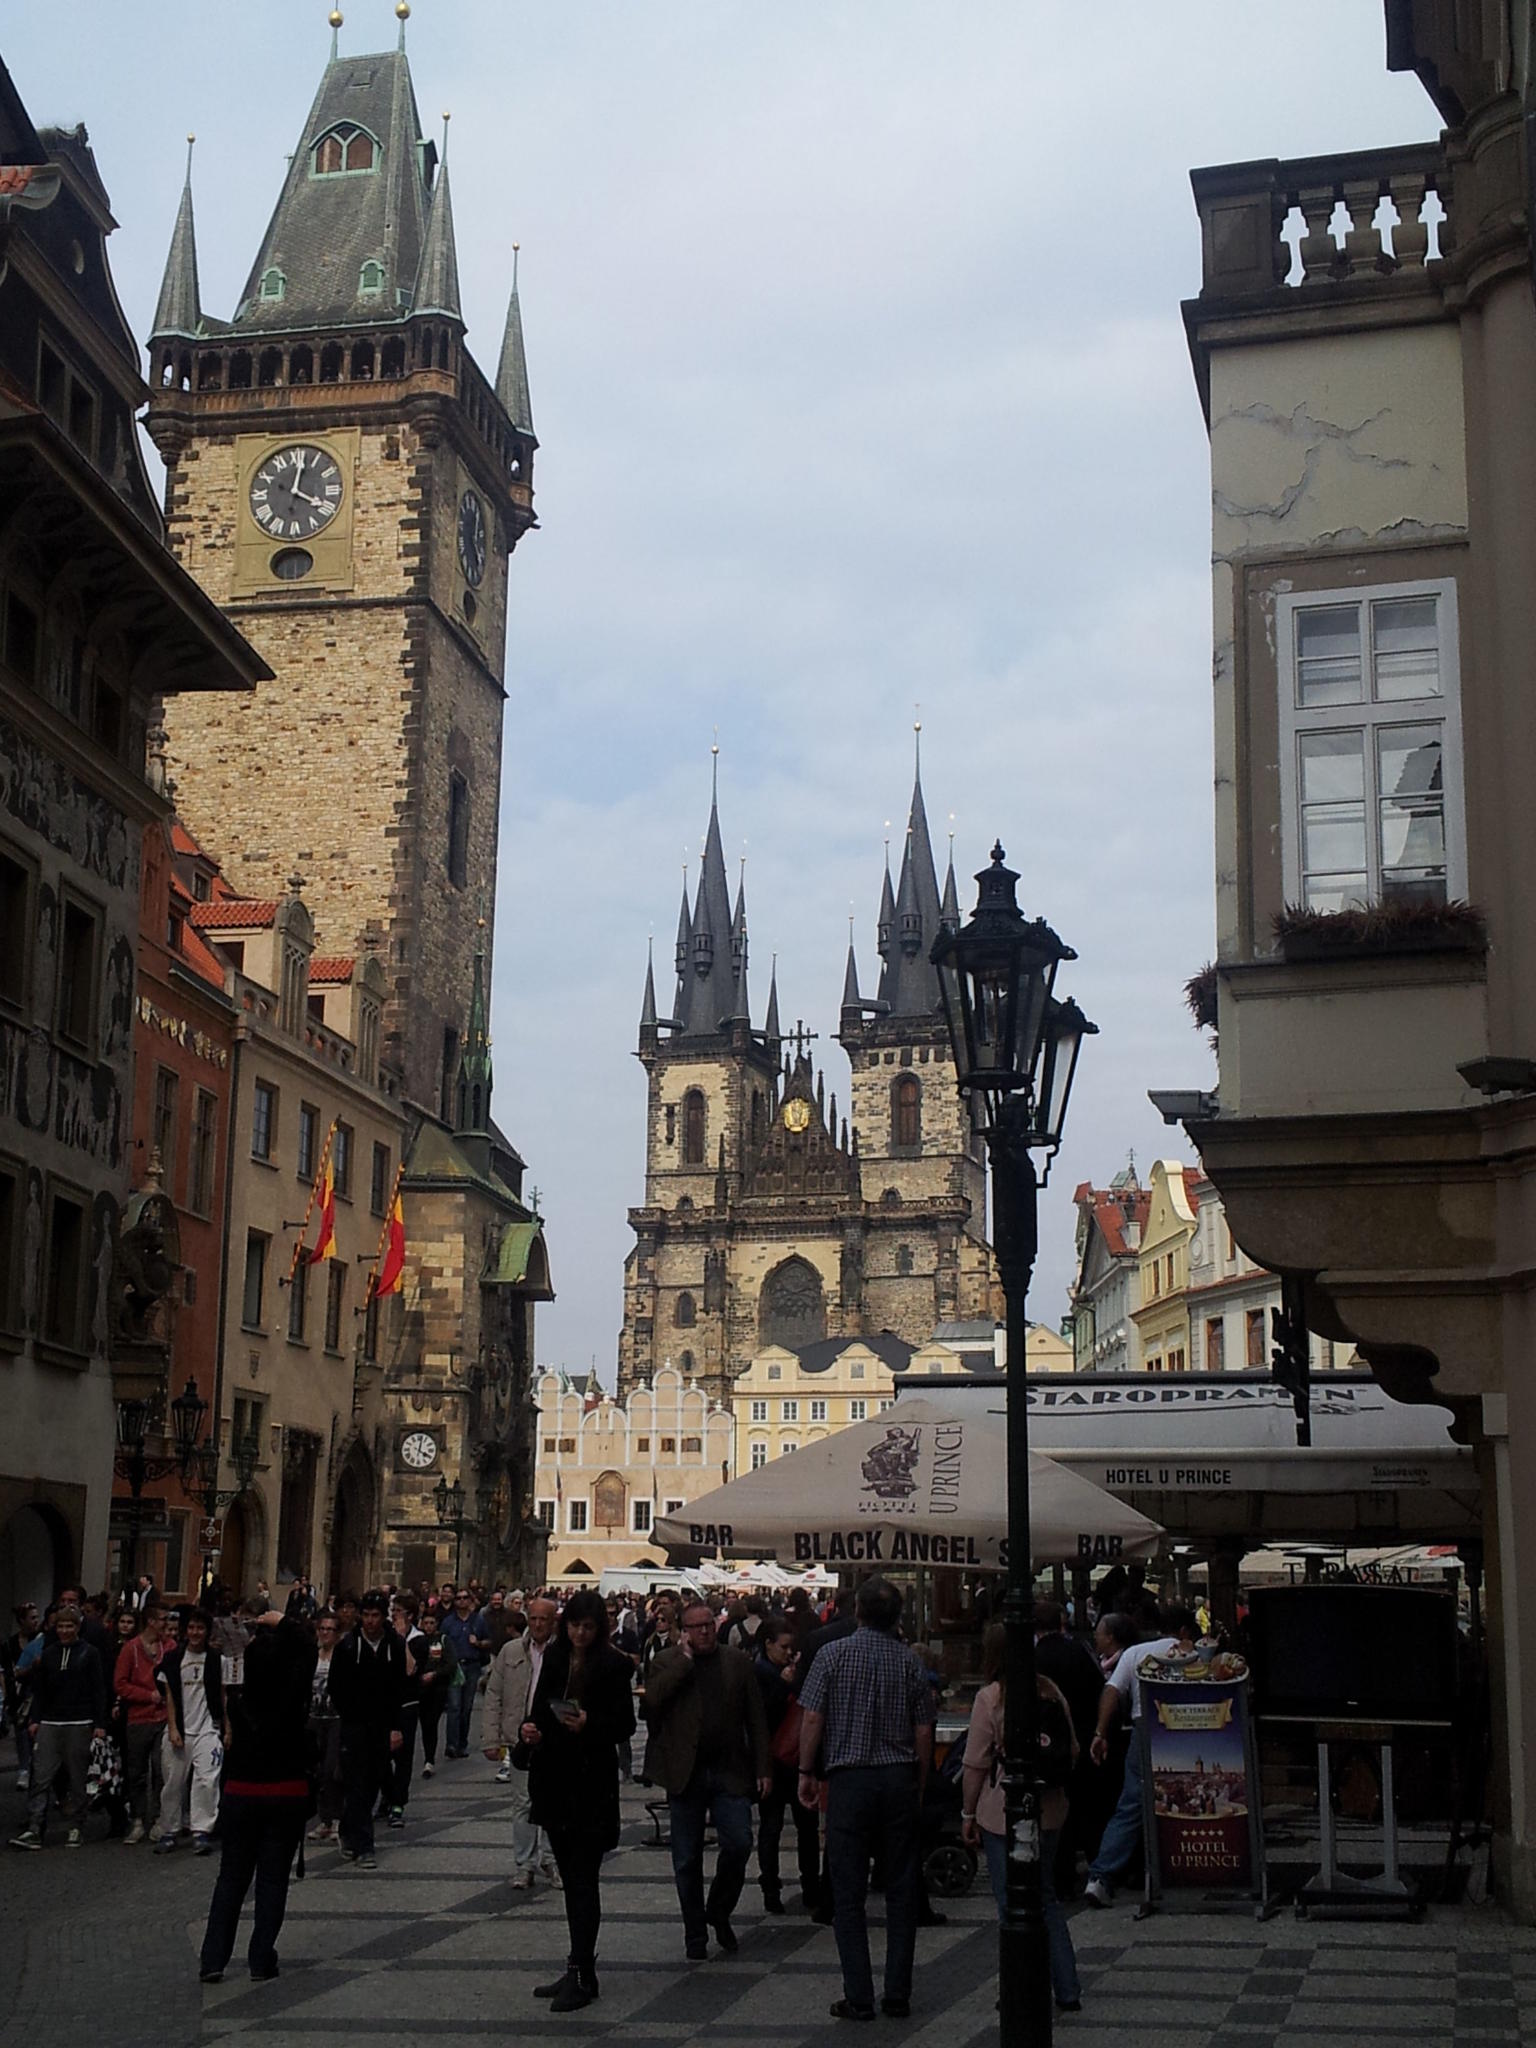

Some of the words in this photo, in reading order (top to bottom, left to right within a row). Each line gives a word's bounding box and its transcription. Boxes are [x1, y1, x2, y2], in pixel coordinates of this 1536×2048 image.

[930, 1425, 963, 1497] PRINCE
[1106, 1469, 1154, 1484] HOTEL
[1160, 1469, 1169, 1484] U
[1176, 1469, 1232, 1485] PRINCE
[929, 1502, 958, 1514] U
[689, 1524, 734, 1546] BAR
[794, 1531, 882, 1561] BLACK
[1078, 1534, 1123, 1557] BAR
[1180, 1842, 1229, 1853] HOTEL
[1171, 1855, 1182, 1867] U
[1186, 1855, 1241, 1867] PRINCE
